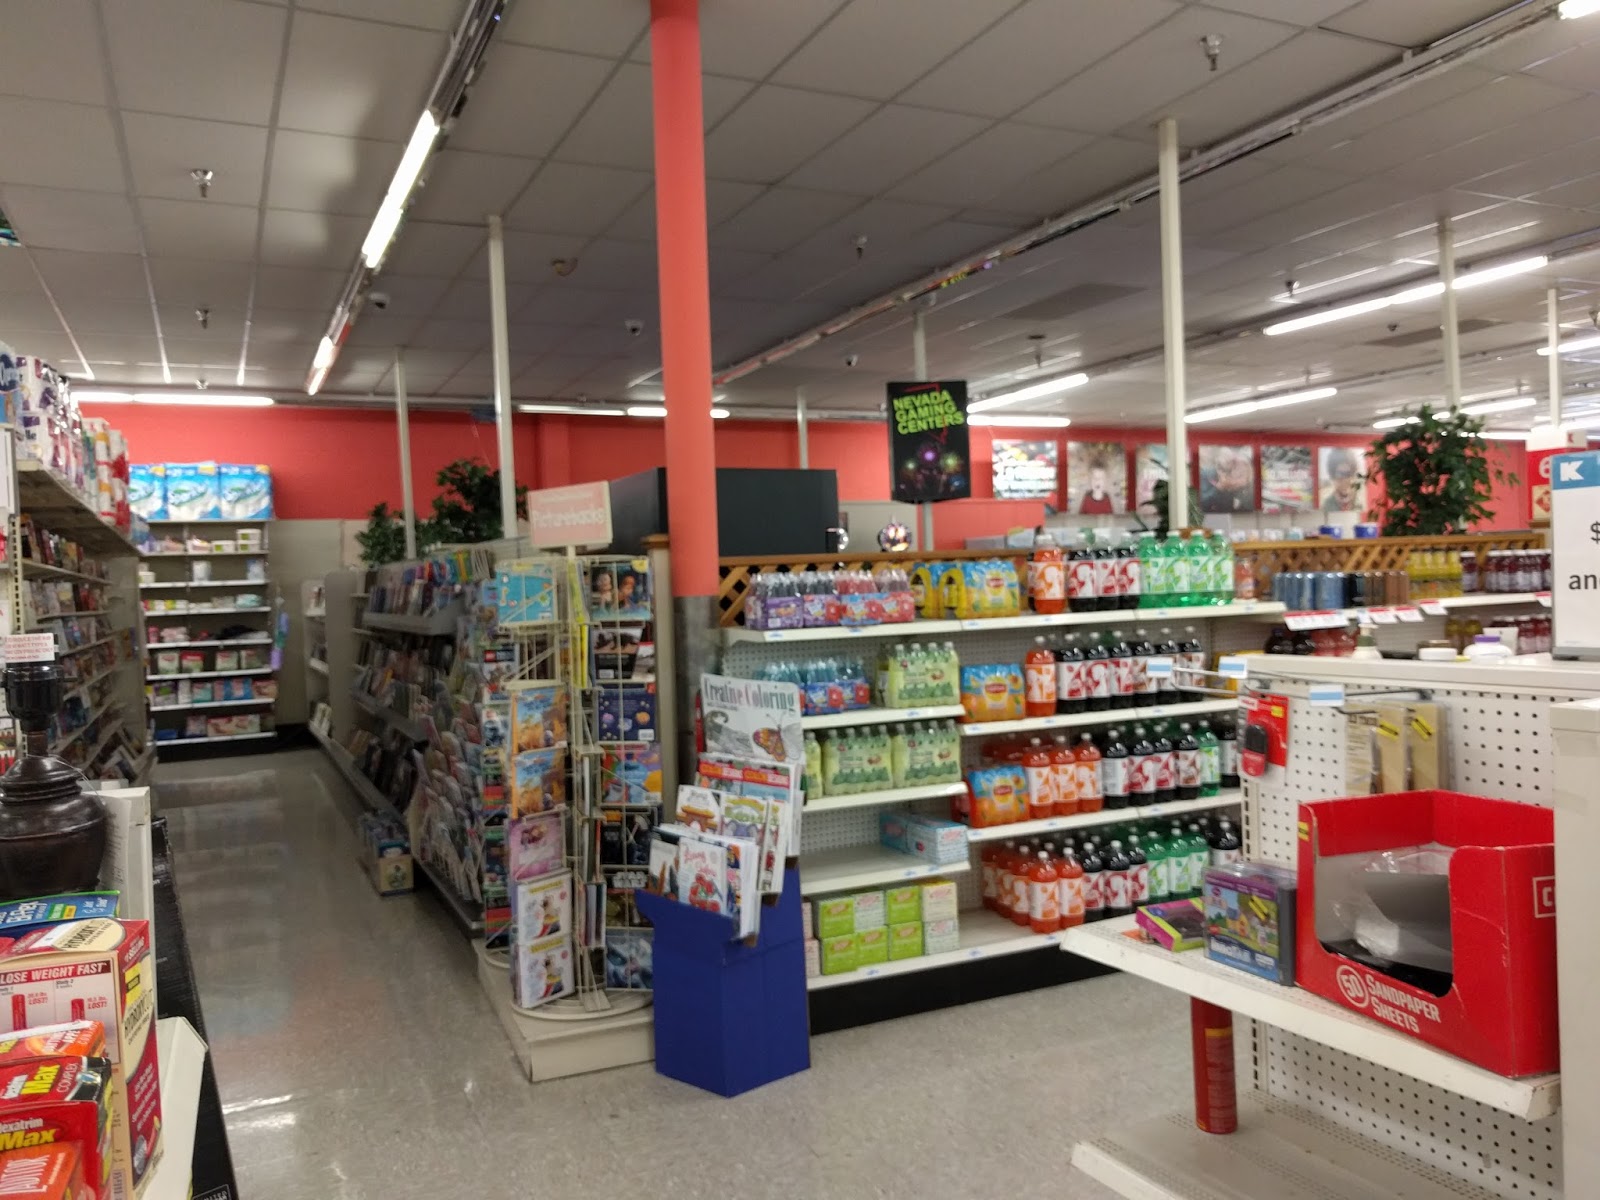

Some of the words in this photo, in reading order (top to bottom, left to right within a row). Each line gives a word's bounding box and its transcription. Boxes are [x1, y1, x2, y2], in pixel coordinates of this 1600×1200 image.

[893, 390, 951, 411] NEVADA
[895, 401, 957, 423] GAMING
[897, 411, 965, 435] CENTERS
[1560, 460, 1584, 481] K
[1568, 574, 1600, 590] an
[0, 971, 28, 985] LOSE
[31, 966, 75, 981] WEIGHT
[1340, 973, 1364, 998] 50
[1365, 974, 1441, 1023] SANDPAPER
[1371, 996, 1420, 1034] SHEETS
[0, 1117, 43, 1133] exatrim
[0, 1128, 57, 1151] Max
